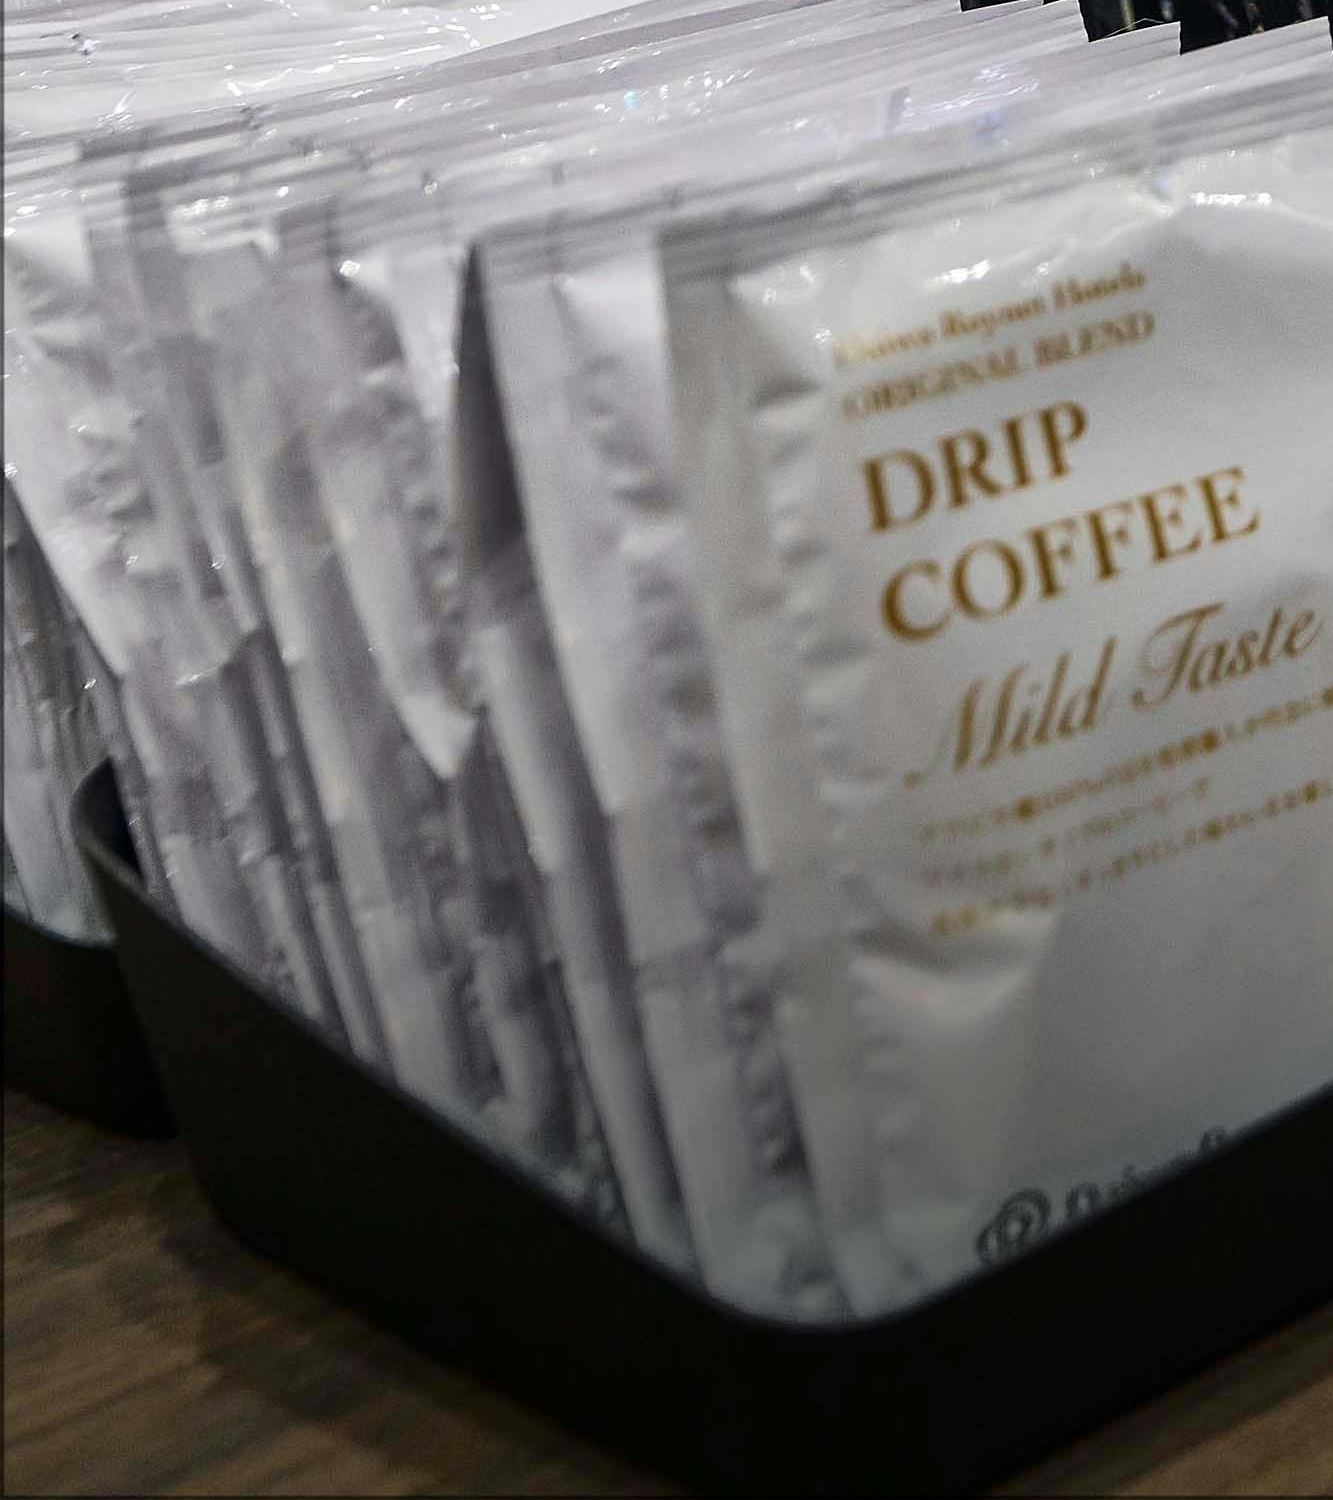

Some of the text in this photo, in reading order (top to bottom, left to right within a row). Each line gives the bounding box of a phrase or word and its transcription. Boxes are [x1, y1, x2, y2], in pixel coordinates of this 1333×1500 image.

[859, 399, 1091, 534] DRIP
[879, 466, 1261, 642] COFFEE
[903, 634, 1119, 789] Mild
[1132, 602, 1325, 707] Taste
